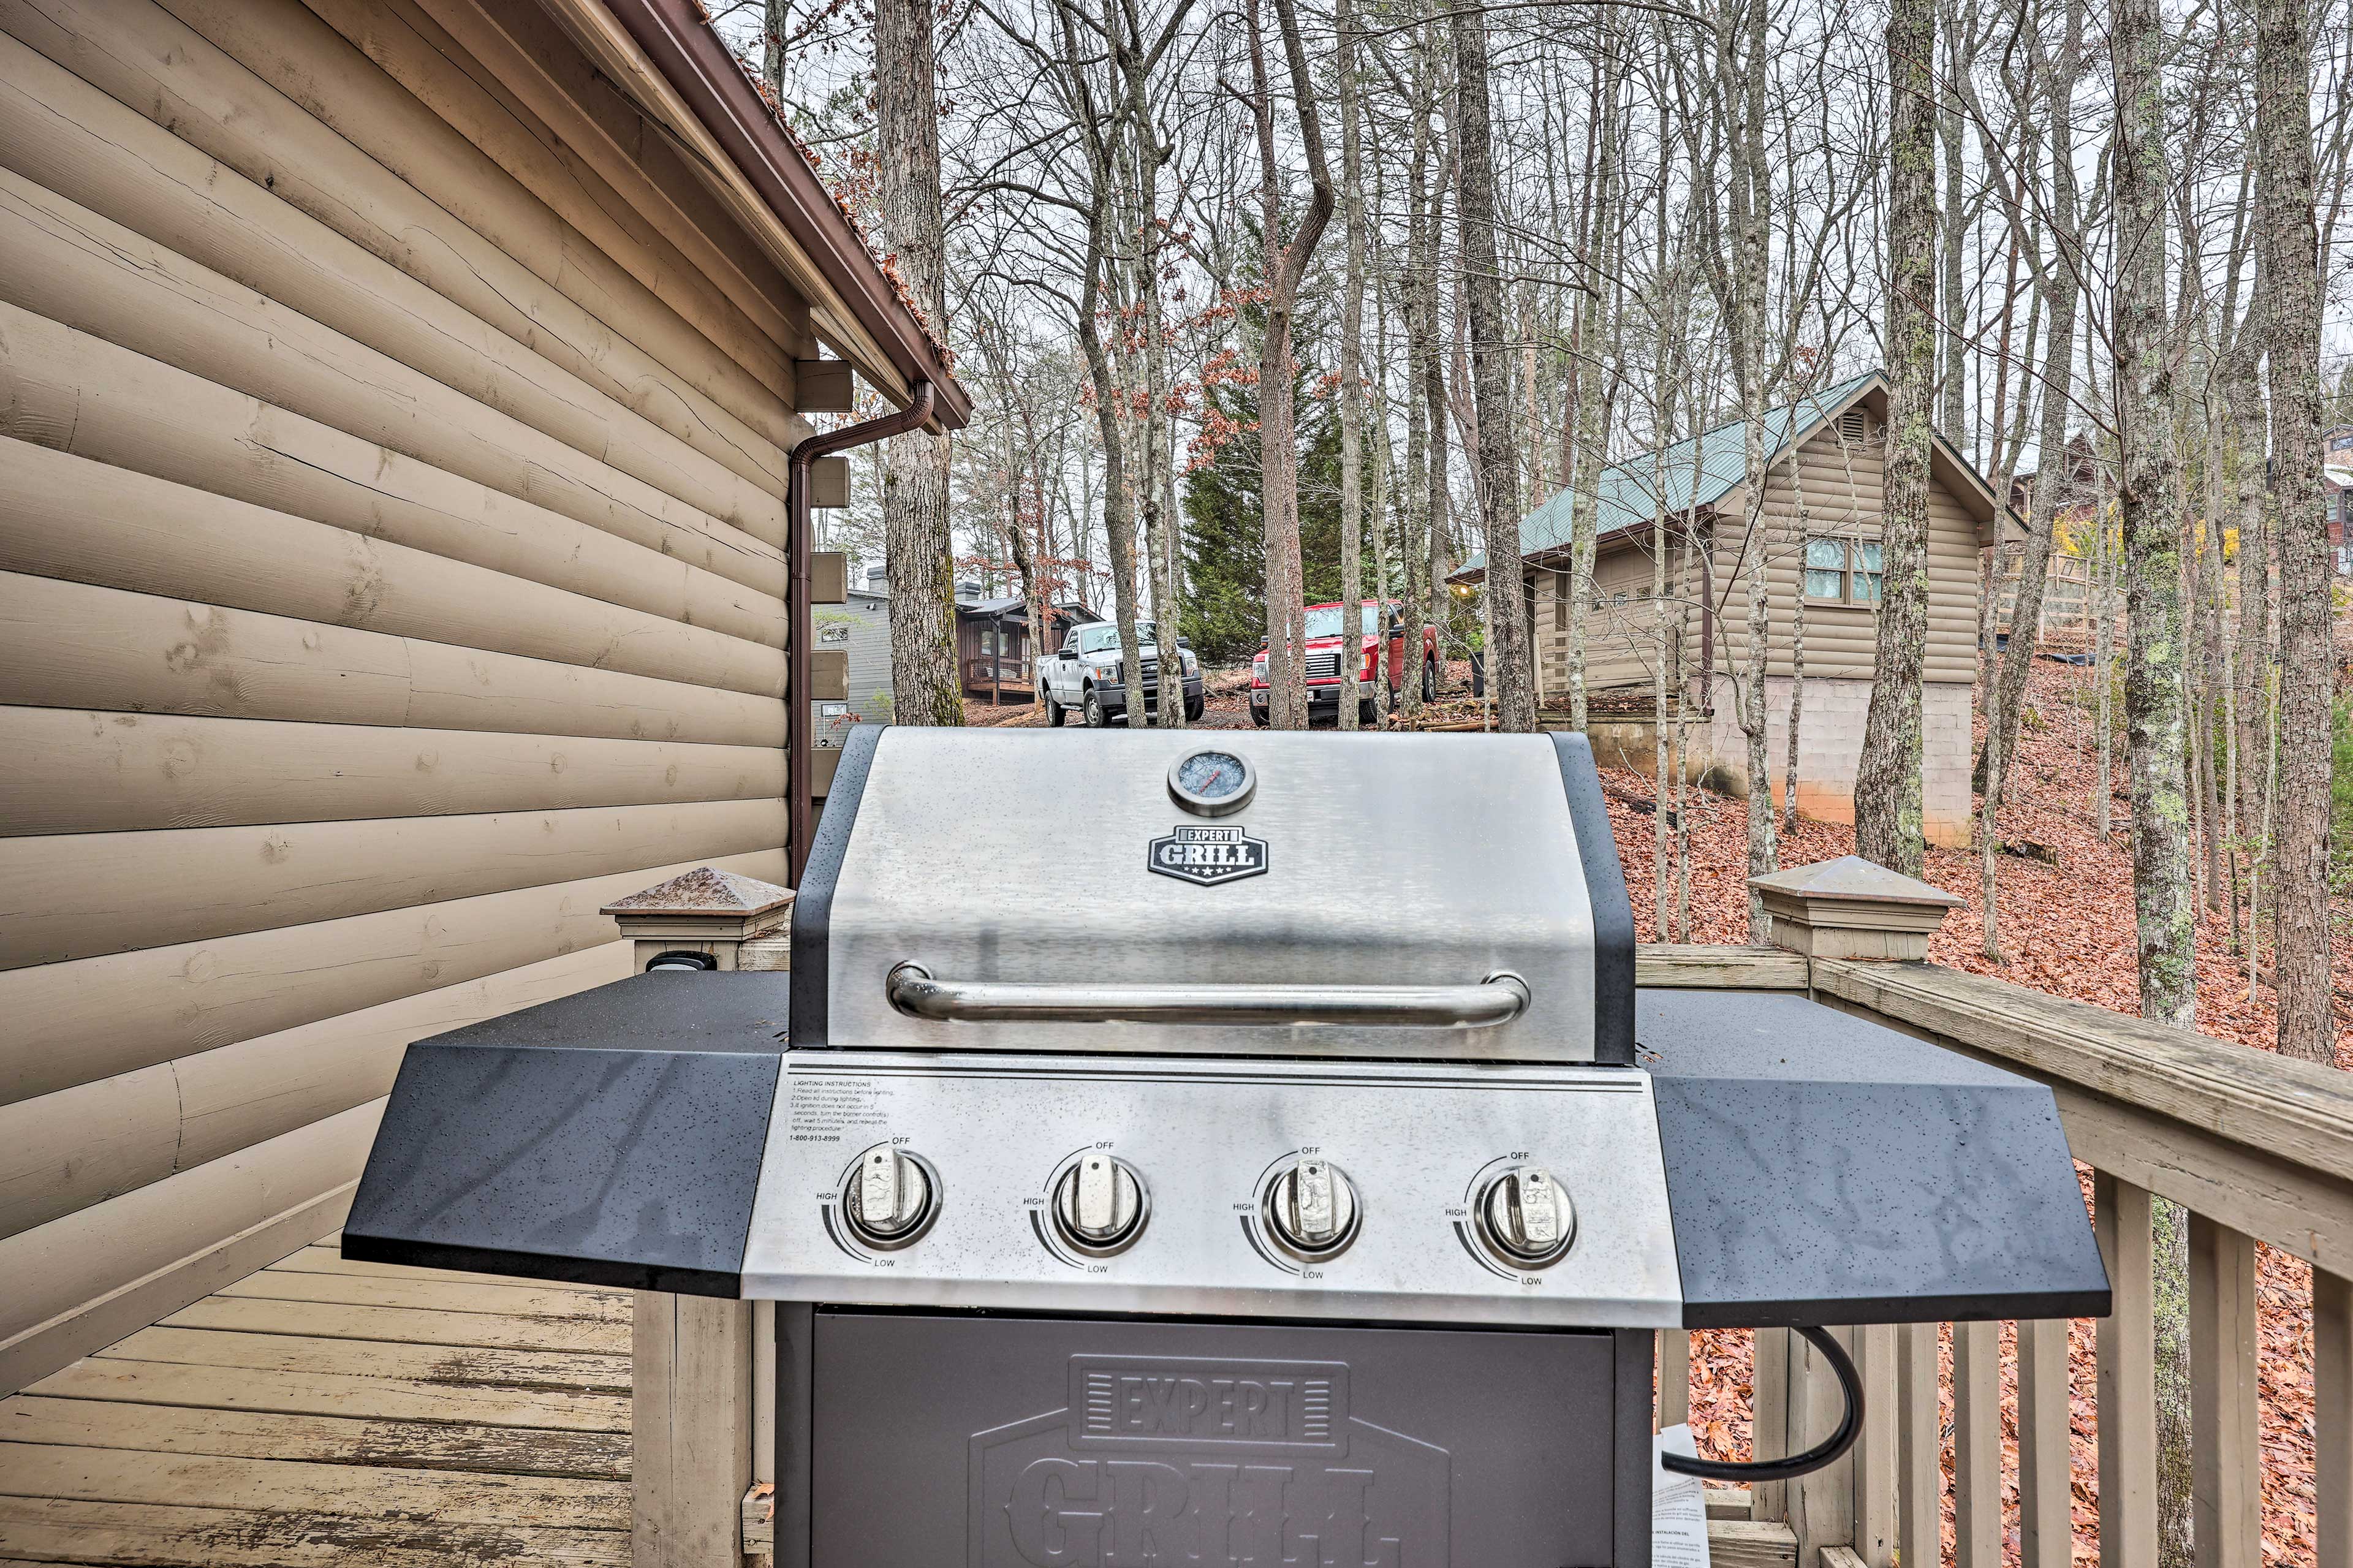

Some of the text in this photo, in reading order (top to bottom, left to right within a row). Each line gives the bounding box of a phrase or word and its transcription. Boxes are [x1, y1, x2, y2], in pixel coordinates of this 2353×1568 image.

[1187, 830, 1230, 841] EXPERT
[1159, 844, 1255, 866] GRILL
[892, 1137, 911, 1145] OFF
[1510, 1151, 1529, 1160] OFF
[1521, 1277, 1542, 1286] LOW
[1120, 1377, 1295, 1437] EXPERT
[1003, 1458, 1401, 1568] GRILL
